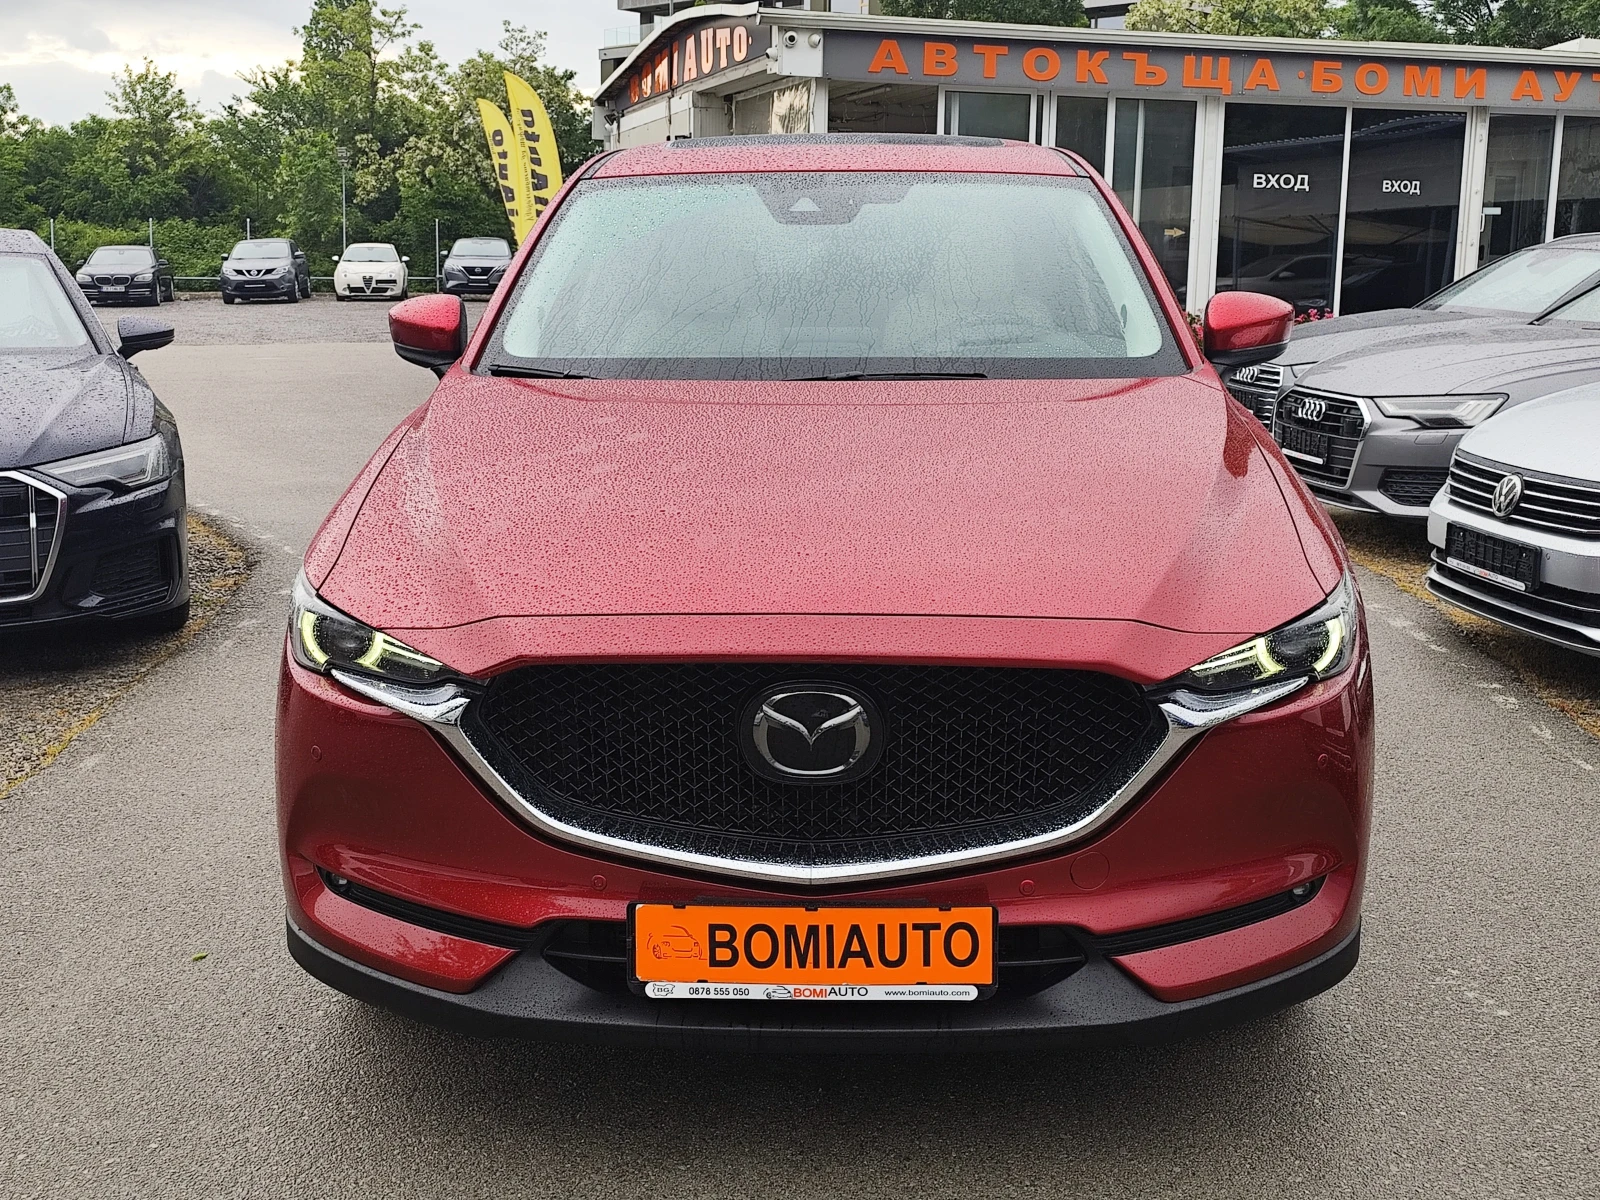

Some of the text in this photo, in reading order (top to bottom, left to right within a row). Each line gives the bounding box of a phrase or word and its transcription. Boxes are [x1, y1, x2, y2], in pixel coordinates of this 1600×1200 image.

[868, 38, 1600, 103] АВТОКЪЩА БОМИ АУ
[1252, 172, 1311, 193] ВХОД
[1381, 179, 1421, 197] ВХОД
[707, 921, 980, 970] BOMIAUTO
[688, 987, 711, 996] 0878
[713, 987, 730, 996] 555
[732, 987, 750, 996] 050
[793, 986, 869, 999] BOMIAUTO
[884, 989, 971, 997] www.bomiauto.com
